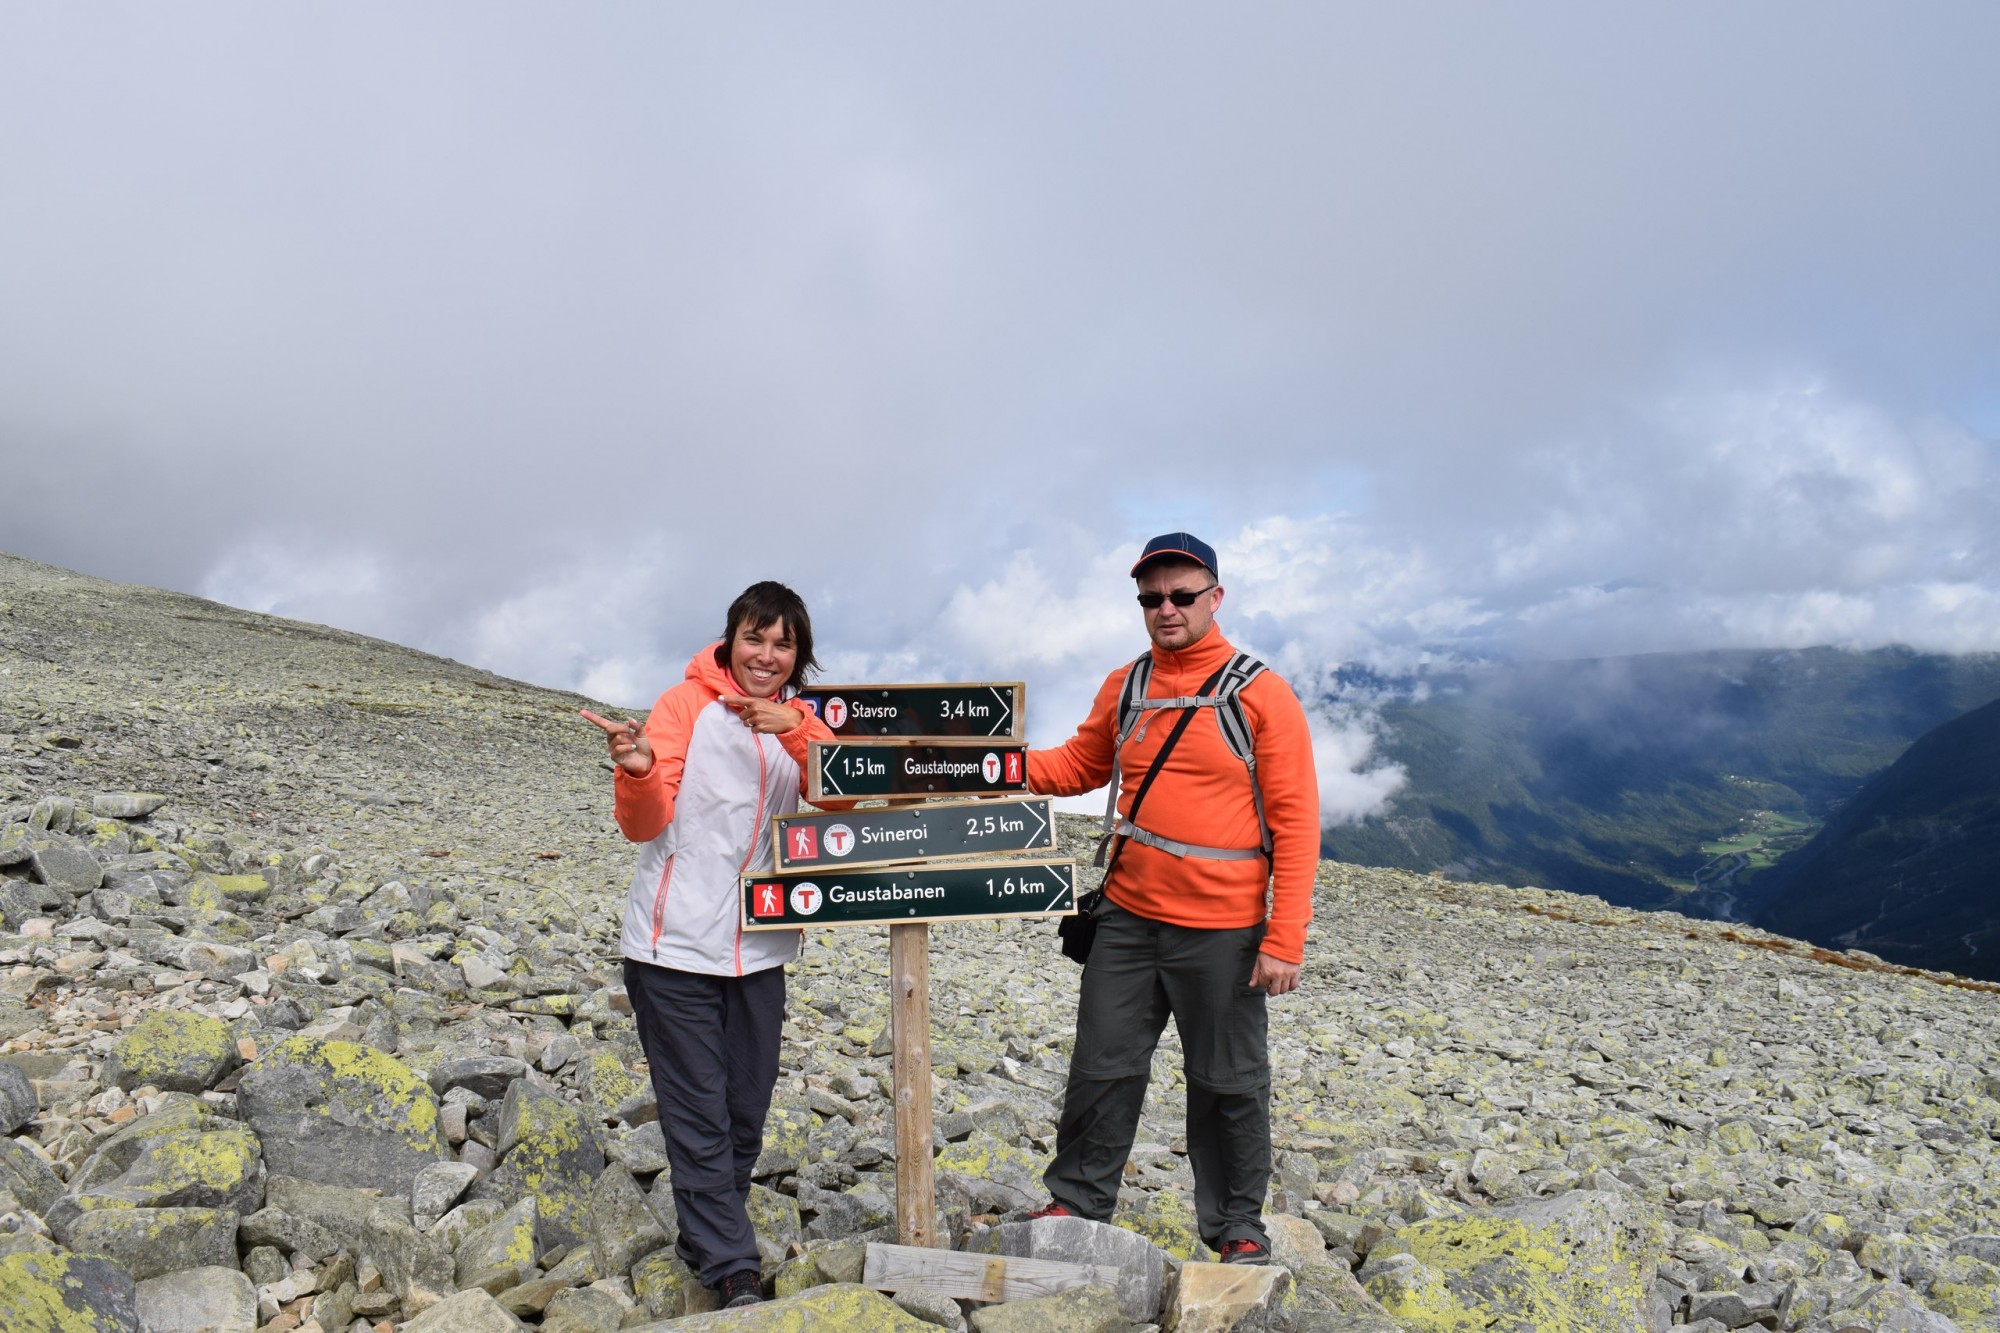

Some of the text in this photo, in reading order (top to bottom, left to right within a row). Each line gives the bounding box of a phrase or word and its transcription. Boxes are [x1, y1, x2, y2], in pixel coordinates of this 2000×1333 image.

[851, 701, 898, 718] Stavsro
[940, 700, 965, 720] 3,4
[968, 700, 989, 717] km
[843, 757, 885, 778] 1,5 km
[904, 757, 980, 778] Gaustatoppen
[861, 815, 1025, 844] Svineroi 2,5 km
[829, 877, 1045, 903] Gaustabanen 1,6 km
